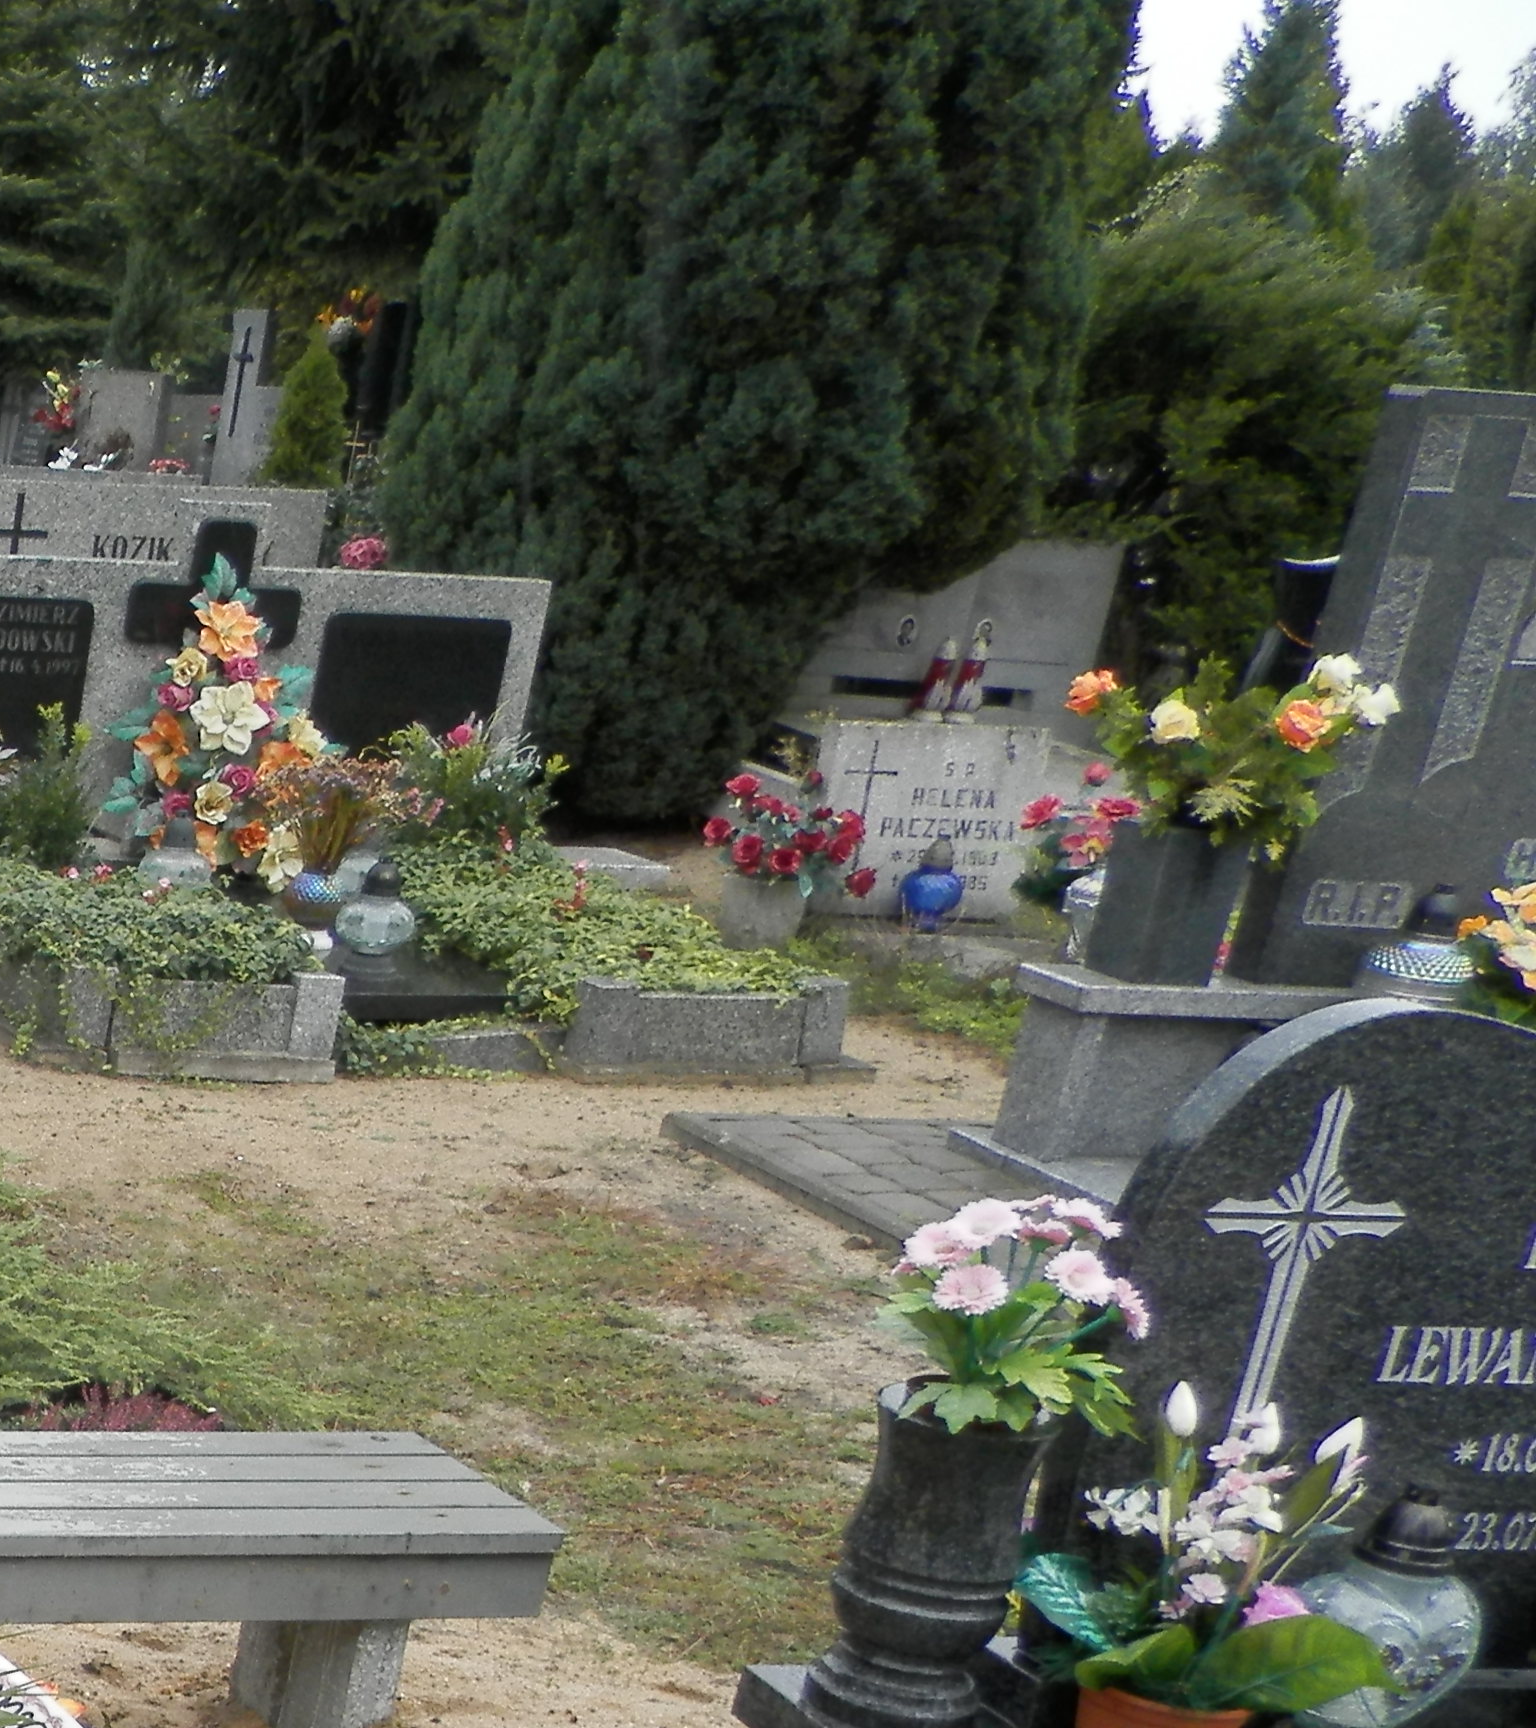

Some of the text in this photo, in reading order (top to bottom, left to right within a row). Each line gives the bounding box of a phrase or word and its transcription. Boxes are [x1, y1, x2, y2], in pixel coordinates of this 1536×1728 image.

[911, 787, 996, 809] HELENA
[880, 816, 1016, 842] PACZEWSKA
[1376, 1326, 1536, 1386] LEWA
